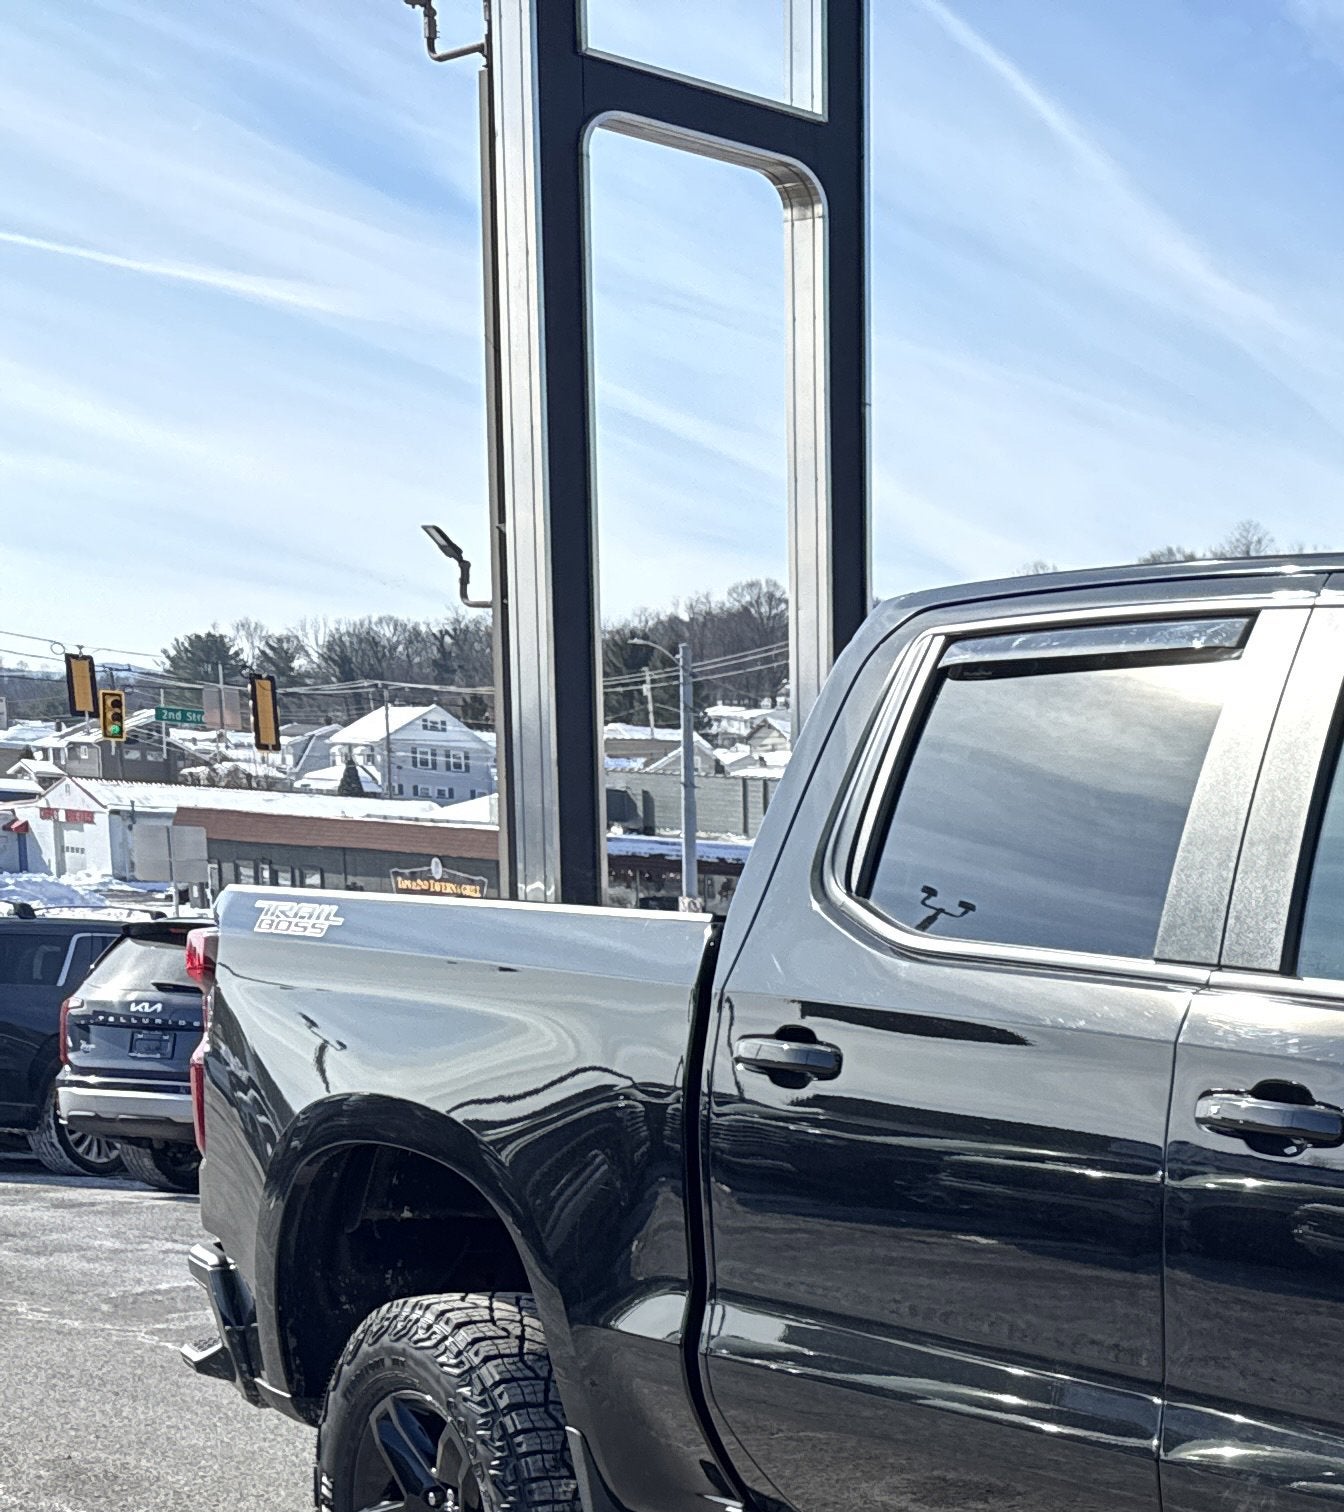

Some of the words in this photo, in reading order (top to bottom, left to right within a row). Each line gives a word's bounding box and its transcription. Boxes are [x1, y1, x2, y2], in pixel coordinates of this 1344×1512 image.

[162, 709, 182, 720] 2nd
[255, 900, 345, 925] TRAIL
[254, 918, 329, 937] BOSS
